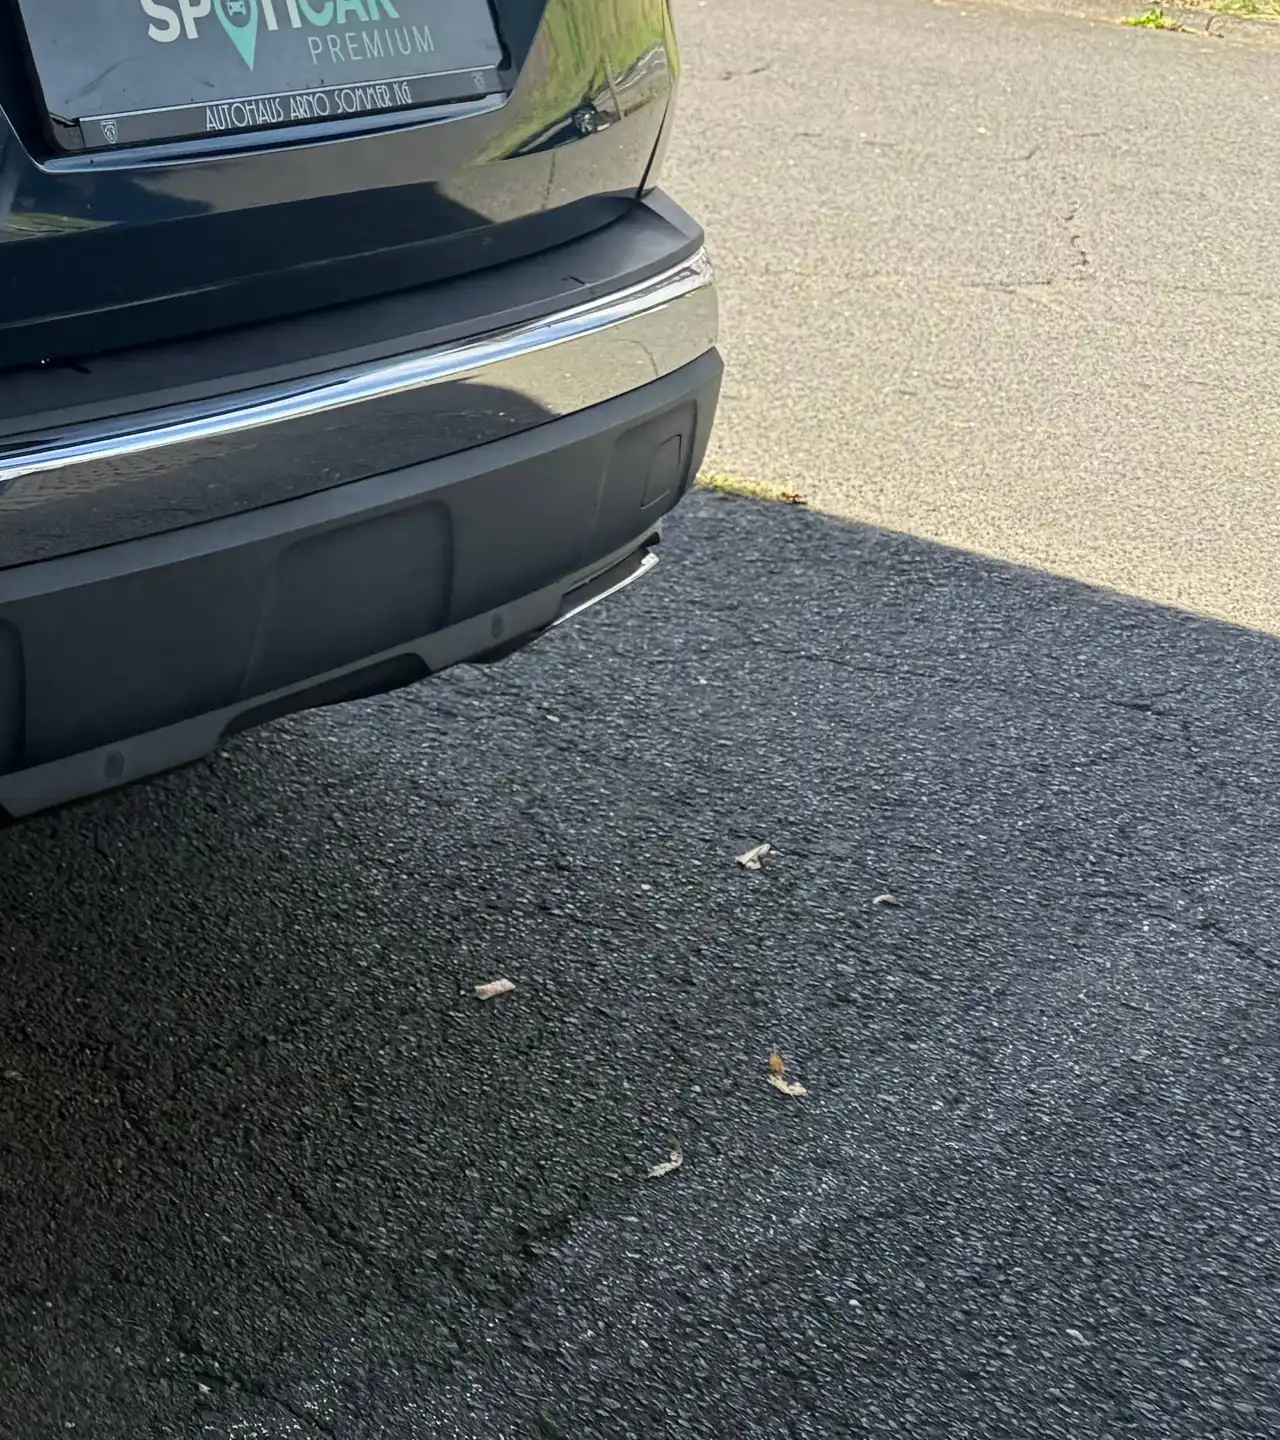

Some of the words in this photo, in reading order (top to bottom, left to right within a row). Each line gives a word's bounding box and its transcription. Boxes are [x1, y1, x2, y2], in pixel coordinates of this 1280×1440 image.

[307, 25, 435, 65] PREMIUM
[205, 97, 284, 132] AUTOHAUS
[289, 92, 330, 120] ARNO
[336, 85, 392, 114] SOMMER
[393, 80, 413, 106] KG
